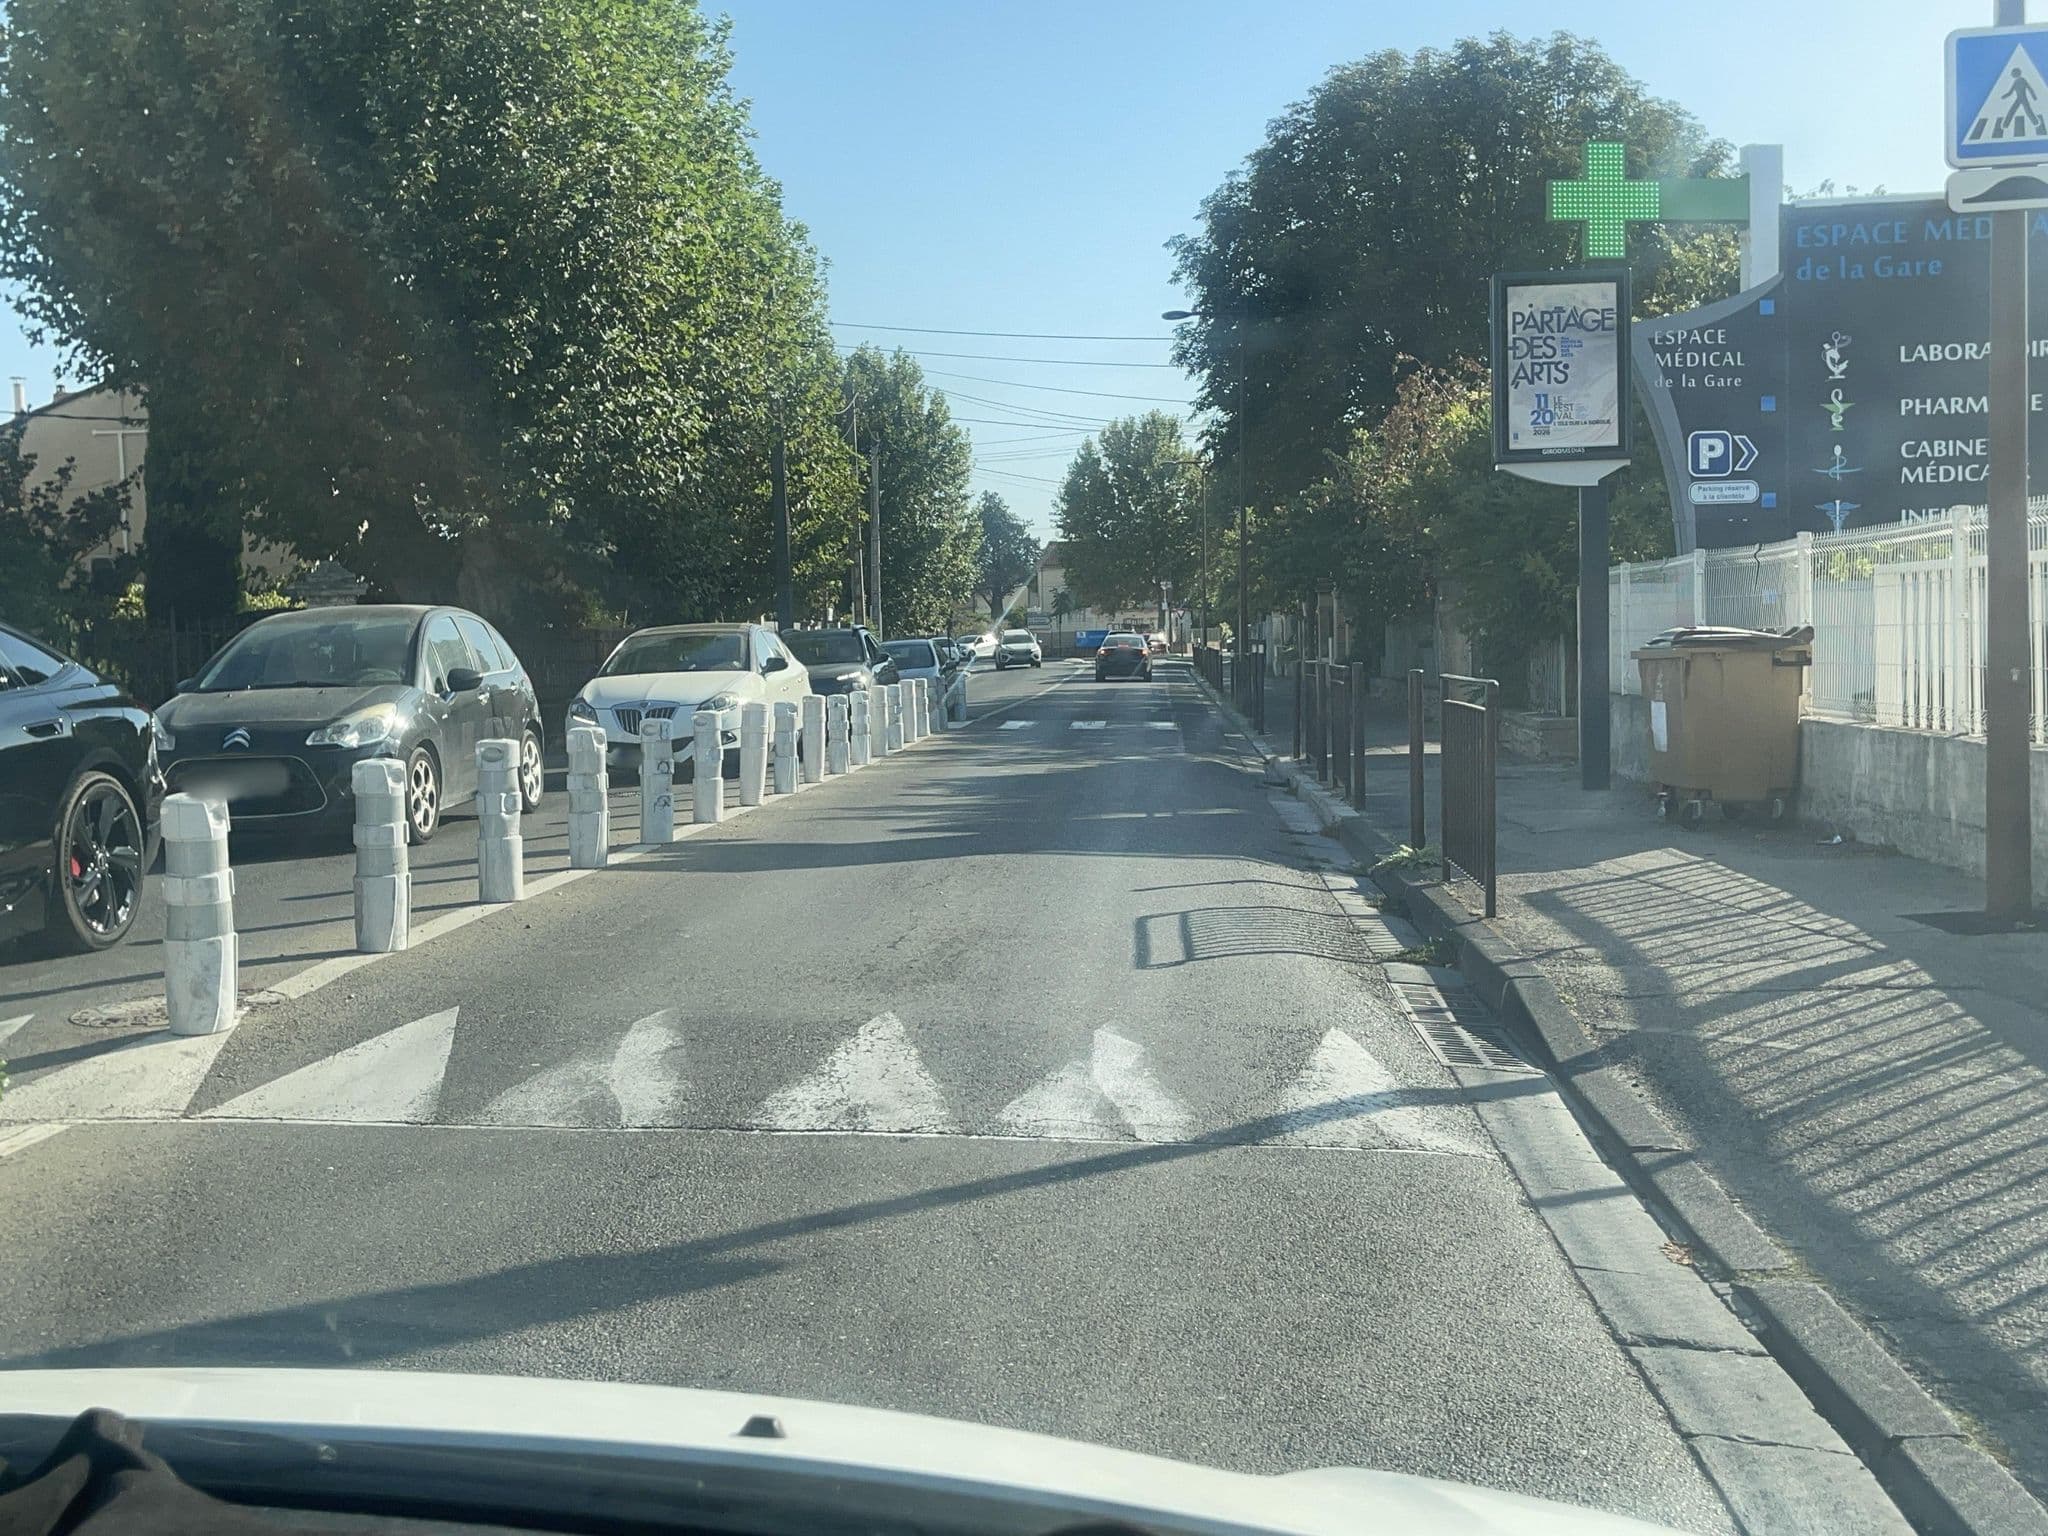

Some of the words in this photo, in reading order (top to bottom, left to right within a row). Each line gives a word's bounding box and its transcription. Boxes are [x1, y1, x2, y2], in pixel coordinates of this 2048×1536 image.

[1796, 221, 1908, 248] ESPACE
[1796, 255, 1831, 281] de
[1840, 255, 1865, 280] la
[1874, 255, 1943, 279] Gare
[1511, 303, 1617, 335] PARTAGE
[1508, 335, 1557, 360] DES
[1654, 328, 1727, 345] ESPACE
[1655, 347, 1745, 368] MÉDICAL
[1511, 360, 1570, 389] ARTS
[1654, 375, 1673, 388] de
[1682, 373, 1696, 388] la
[1704, 374, 1743, 388] Gare
[1900, 394, 2043, 416] PHARME
[1530, 410, 1554, 426] 20
[1699, 438, 1725, 470] P
[1900, 438, 1989, 458] CABINE
